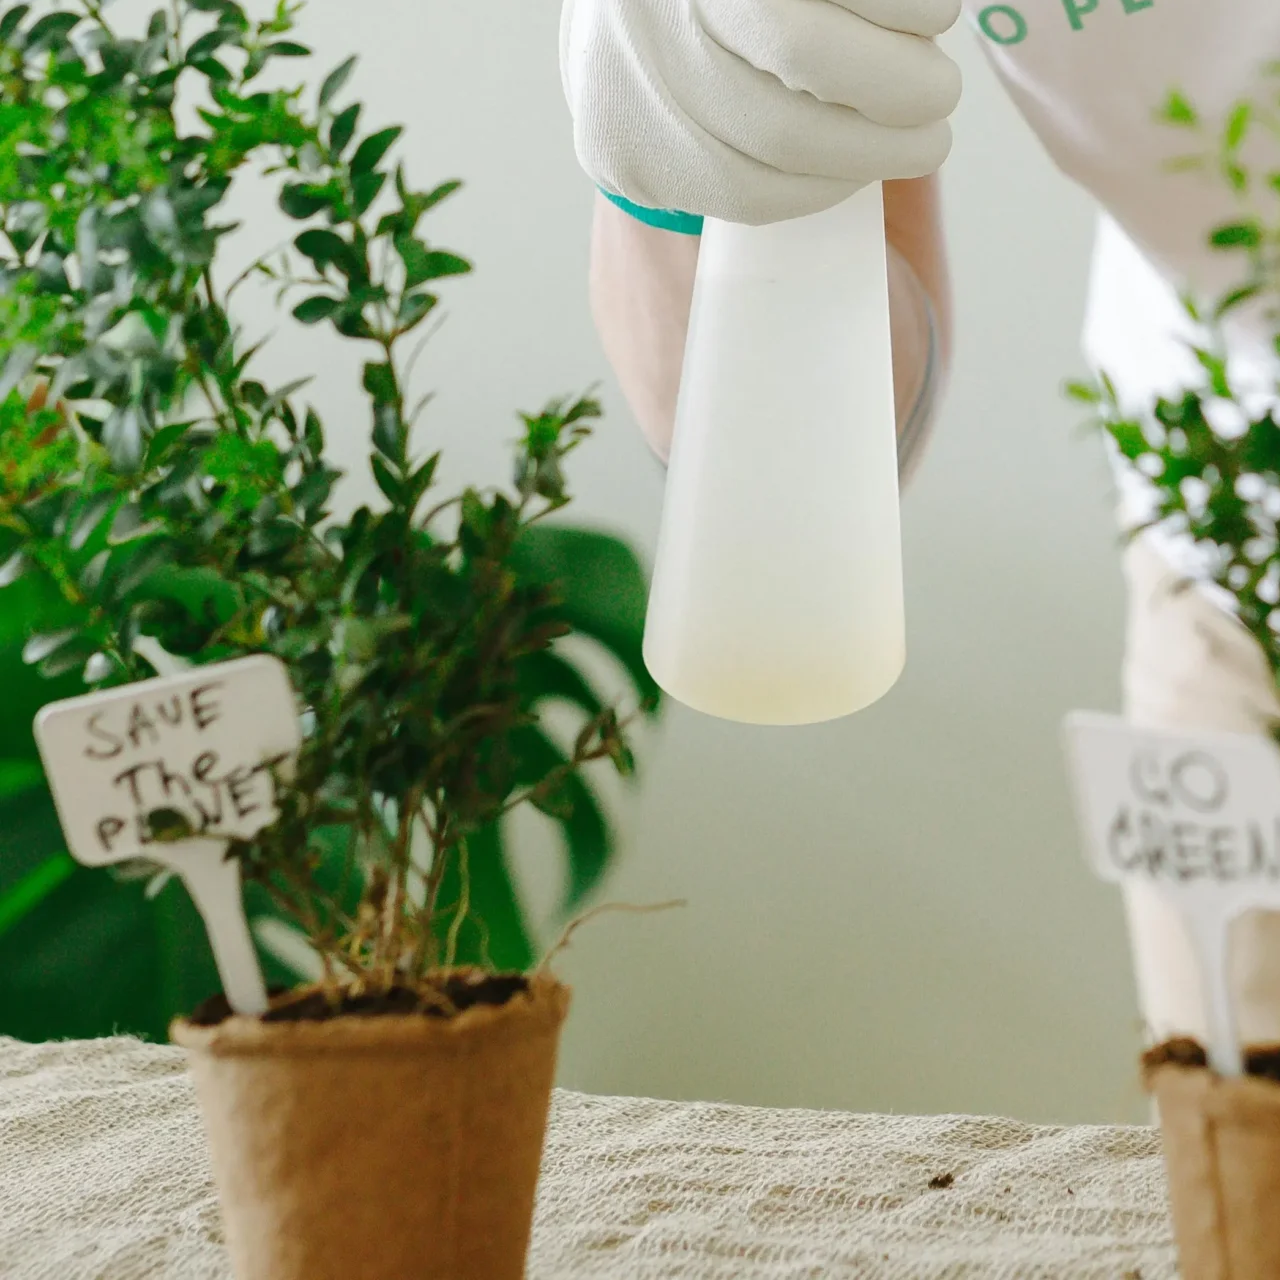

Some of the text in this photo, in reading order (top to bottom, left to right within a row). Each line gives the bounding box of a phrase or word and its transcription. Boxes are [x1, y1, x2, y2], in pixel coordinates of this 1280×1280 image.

[83, 678, 228, 759] SAVE
[95, 751, 290, 852] PLNET
[112, 750, 221, 808] The
[1128, 746, 1230, 815] GO
